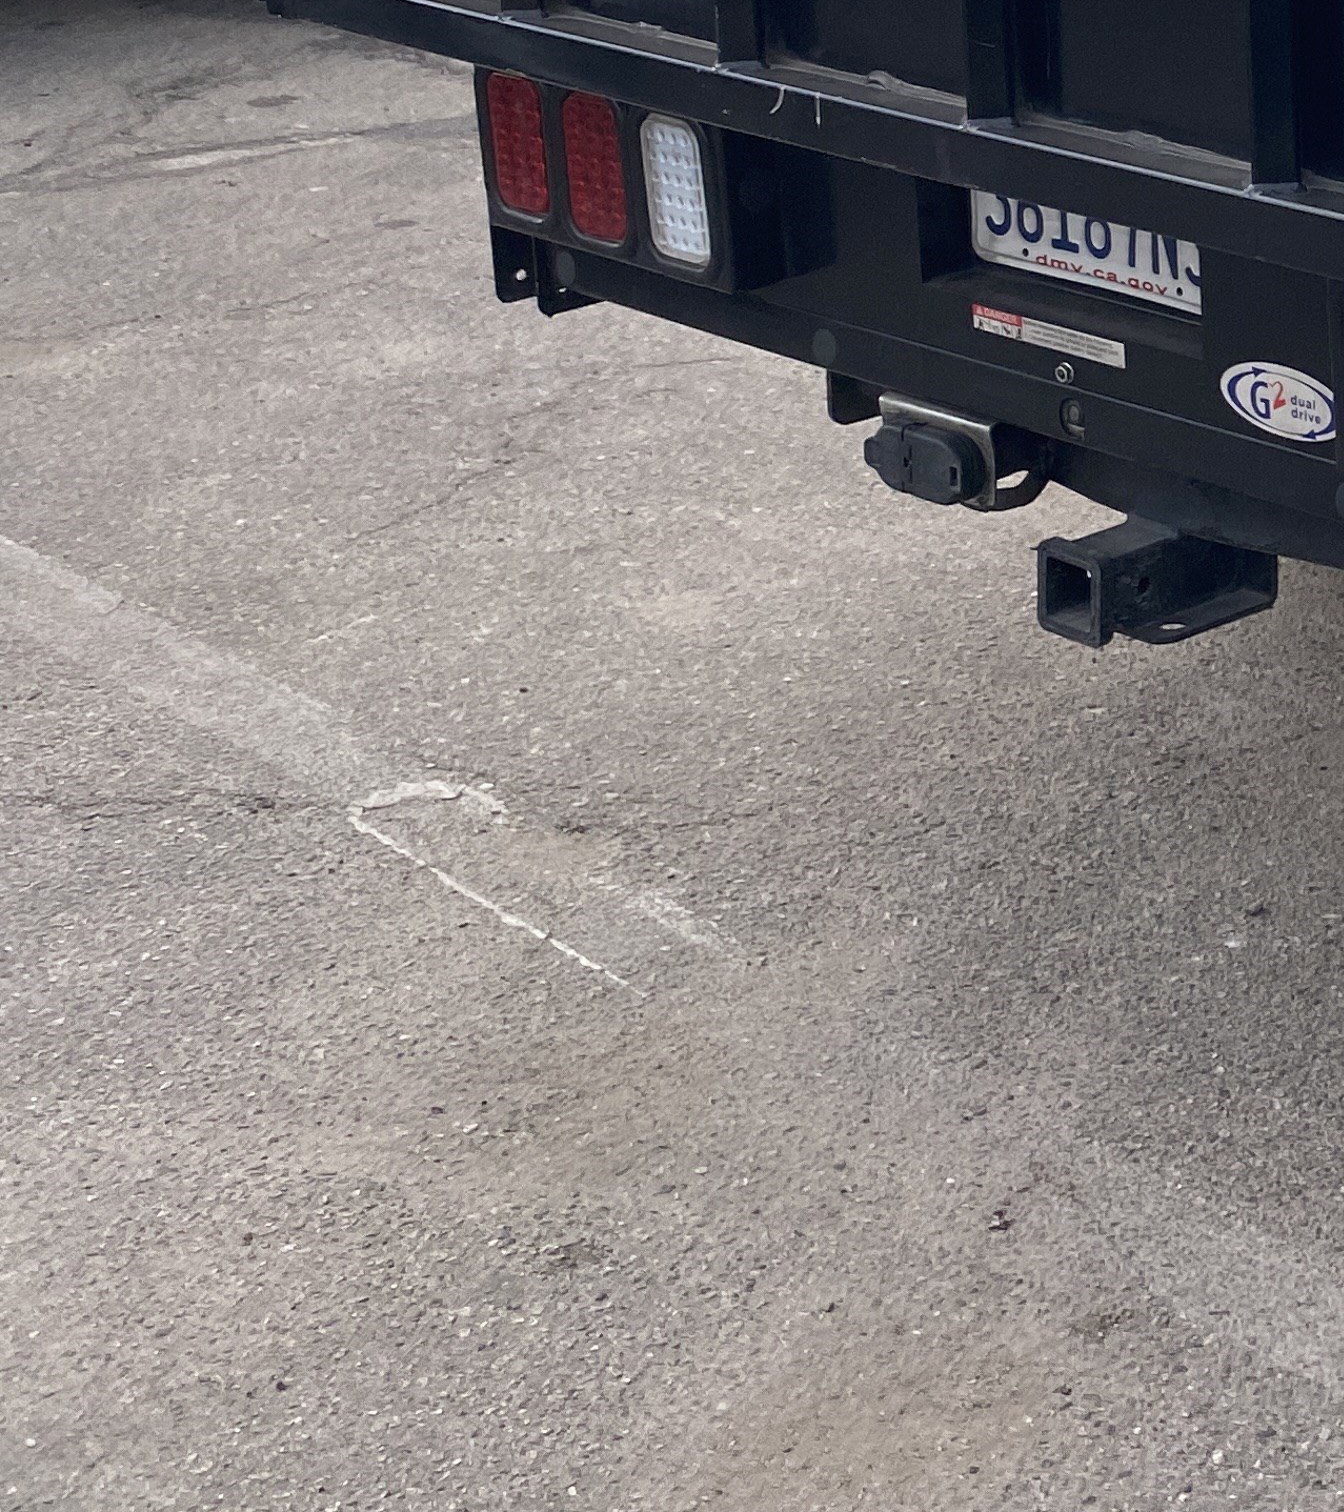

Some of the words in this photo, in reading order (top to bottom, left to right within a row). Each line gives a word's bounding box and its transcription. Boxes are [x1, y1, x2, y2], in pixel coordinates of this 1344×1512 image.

[1035, 254, 1168, 296] dmv.ca.gov
[1290, 395, 1316, 409] dual
[1291, 408, 1321, 424] drive
